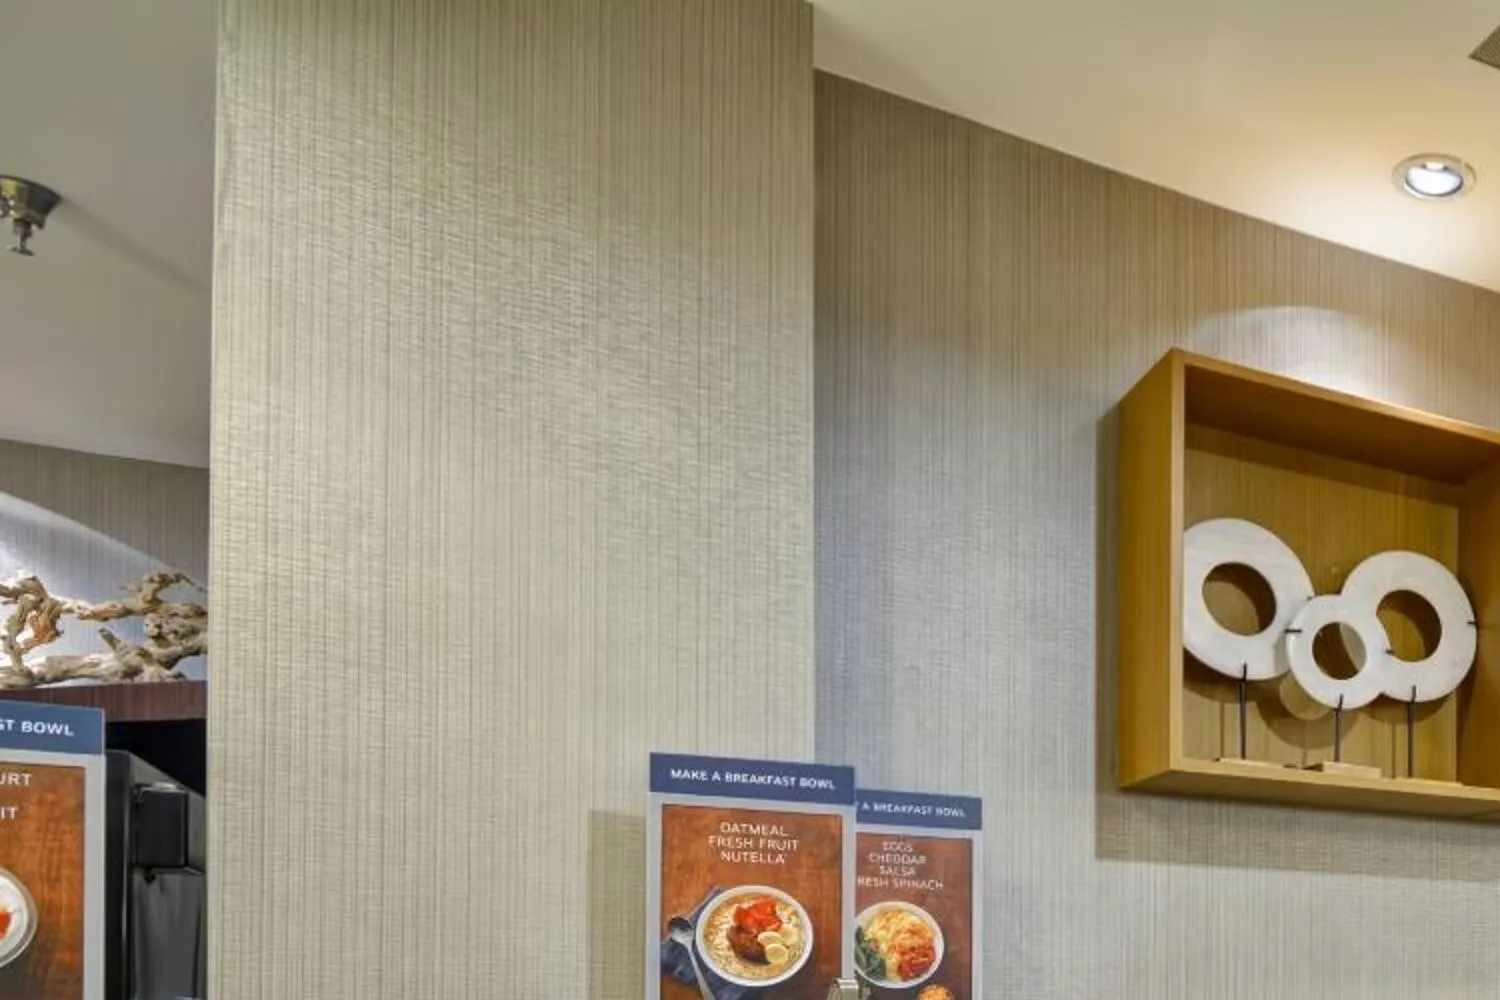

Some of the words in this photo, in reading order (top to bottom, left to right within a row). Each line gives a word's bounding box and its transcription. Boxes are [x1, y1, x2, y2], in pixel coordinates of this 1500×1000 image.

[21, 720, 75, 737] BOWL
[670, 768, 708, 781] MAKE
[711, 770, 721, 782] A
[725, 771, 796, 788] BREAKFAST
[799, 777, 837, 791] BOWL
[861, 801, 871, 812] A
[873, 802, 932, 816] BREAKFAST
[935, 807, 967, 818] BOWL
[720, 821, 789, 837] OATMEAL
[708, 835, 752, 850] FRESH
[759, 838, 800, 851] FRUIT
[882, 841, 914, 853] EGGS
[720, 851, 786, 865] NUTELLA
[867, 852, 927, 866] CHEDDAR
[879, 865, 916, 877] SALSA
[894, 877, 944, 890] SPINACH
